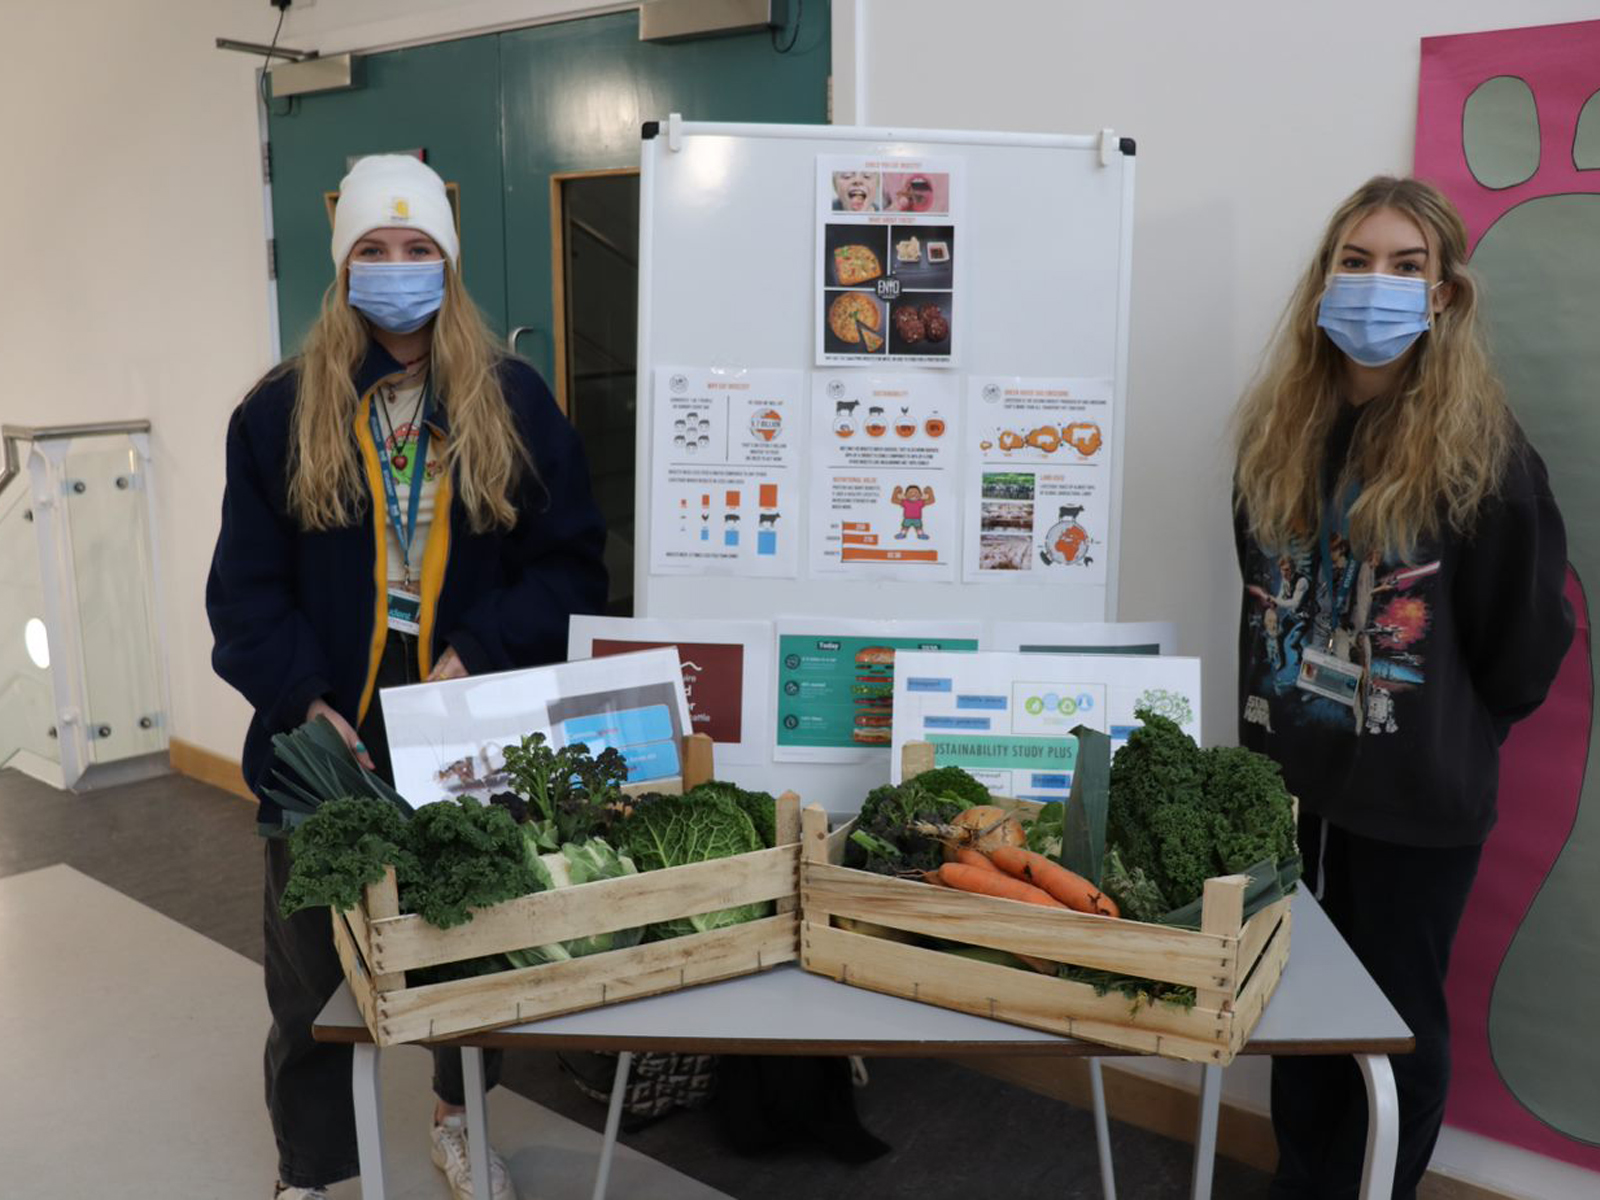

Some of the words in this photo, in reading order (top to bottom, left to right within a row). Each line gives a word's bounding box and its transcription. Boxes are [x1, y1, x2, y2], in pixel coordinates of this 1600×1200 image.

[388, 608, 411, 621] udent
[819, 641, 840, 651] Today
[935, 742, 1008, 758] USTAINABILITY
[1012, 745, 1043, 759] STUDY
[1047, 746, 1073, 760] PLUS
